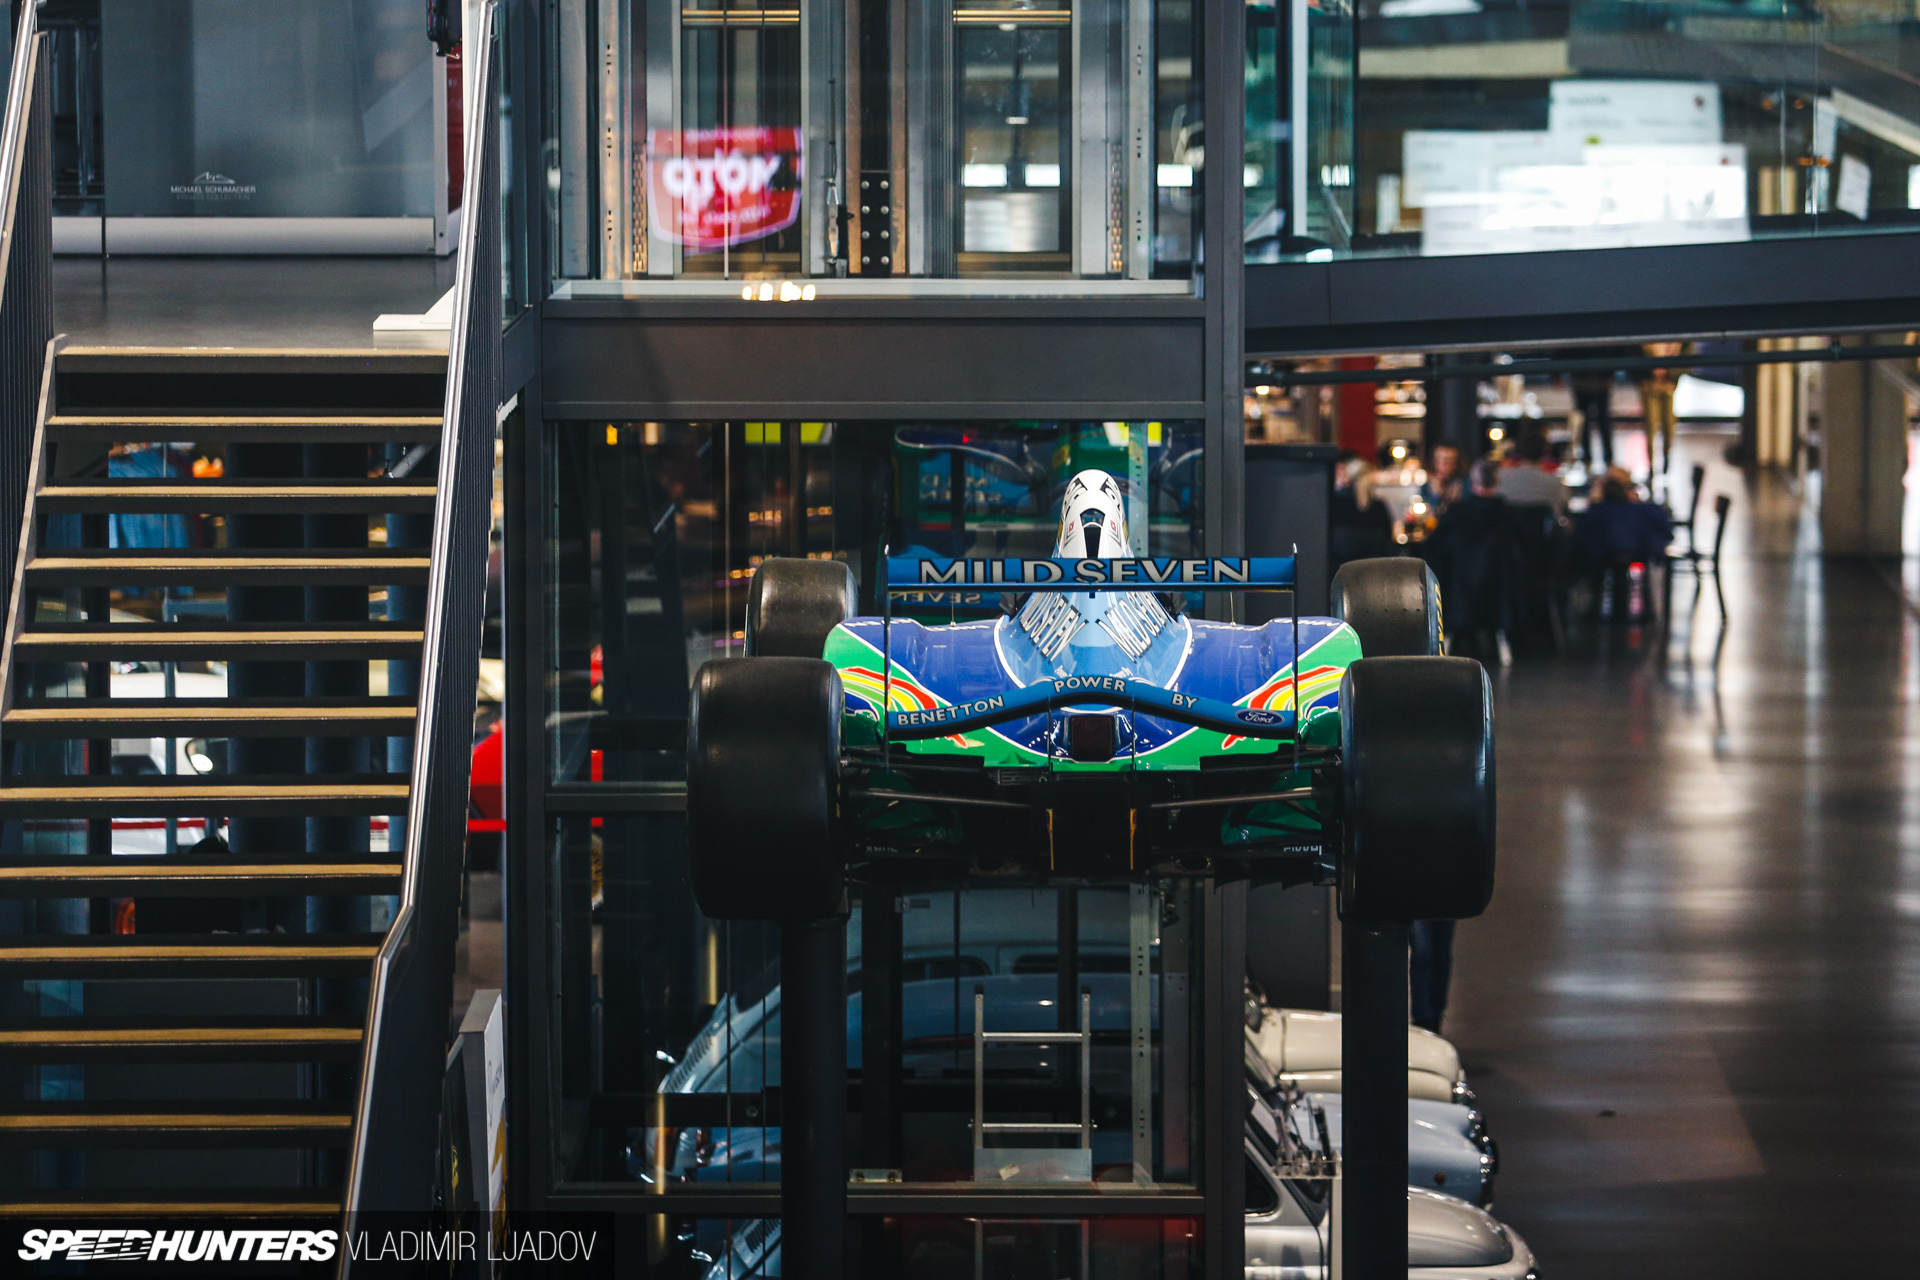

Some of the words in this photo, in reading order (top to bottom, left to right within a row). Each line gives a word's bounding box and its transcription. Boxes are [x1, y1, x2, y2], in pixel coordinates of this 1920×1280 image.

[170, 185, 202, 193] MICHAEL
[204, 185, 256, 193] SCHUMACHER
[919, 558, 1064, 583] MILD
[1073, 558, 1250, 583] SEVEN
[1029, 592, 1089, 664] SEVEN
[1095, 599, 1153, 664] MILD
[897, 695, 1005, 726] BENETTON
[1053, 676, 1126, 693] POWER
[1171, 692, 1198, 709] BY
[1244, 711, 1275, 724] Ford
